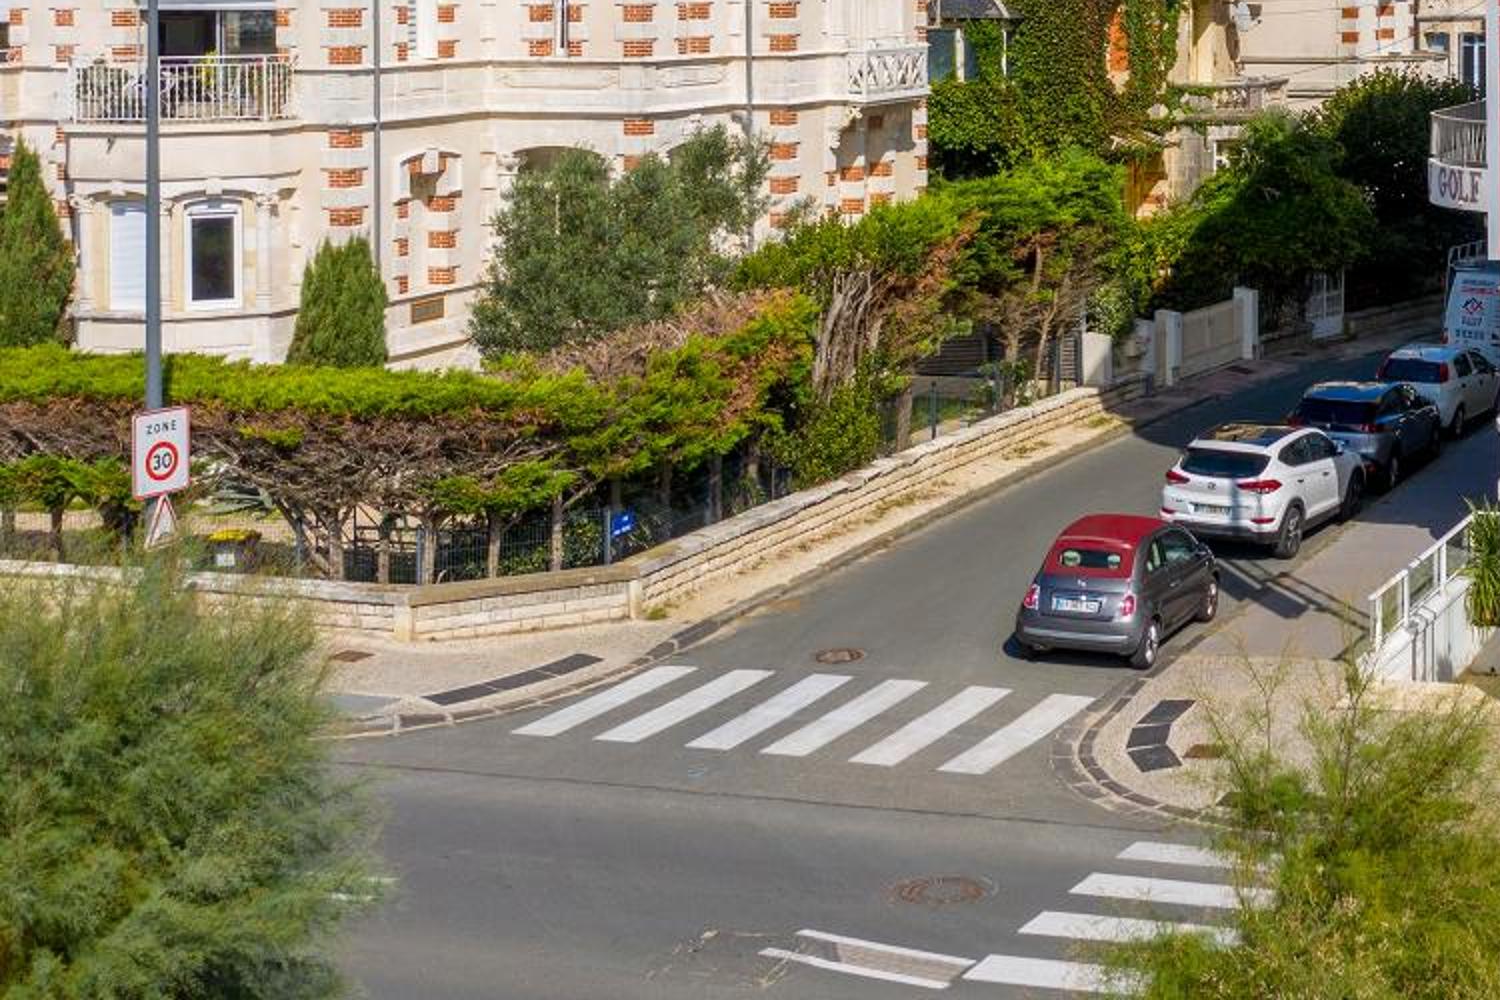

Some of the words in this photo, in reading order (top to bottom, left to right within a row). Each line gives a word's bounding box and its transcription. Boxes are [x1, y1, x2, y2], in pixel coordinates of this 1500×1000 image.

[1438, 168, 1483, 203] GOLF
[145, 419, 177, 435] ZONE
[153, 452, 172, 470] 30
